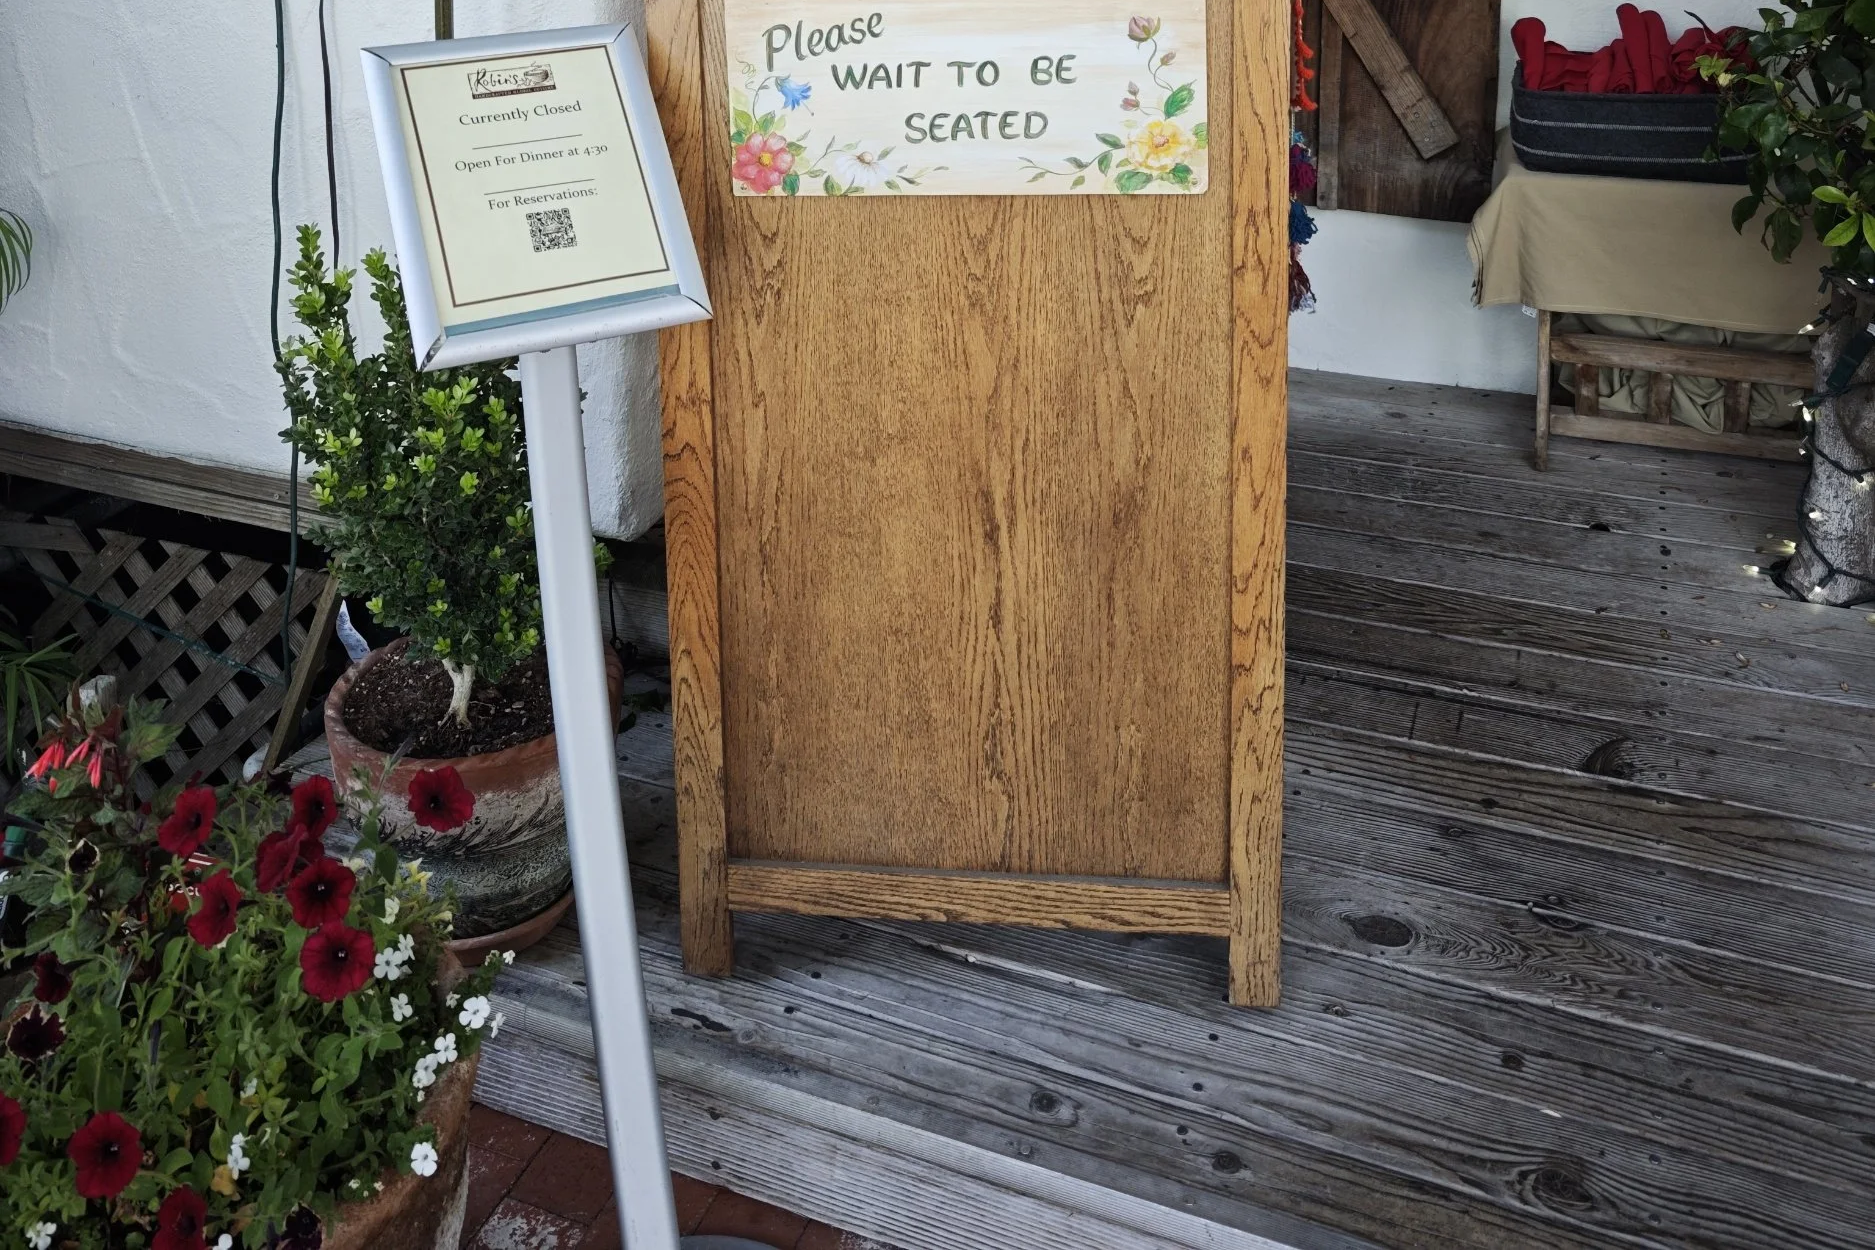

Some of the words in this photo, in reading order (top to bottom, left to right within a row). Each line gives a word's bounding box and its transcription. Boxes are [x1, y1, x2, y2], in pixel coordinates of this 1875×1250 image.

[762, 12, 885, 72] Please
[474, 68, 518, 92] Robin's
[831, 61, 932, 90] WAIT
[947, 60, 1000, 87] TO
[1030, 54, 1077, 86] BE
[459, 108, 529, 125] Currently
[533, 100, 582, 117] Closed
[904, 111, 1049, 144] SEATED
[455, 159, 491, 172] Open
[495, 155, 516, 166] For
[520, 150, 564, 163] Dinner
[567, 147, 580, 156] at
[583, 144, 608, 156] 4:30
[488, 198, 510, 210] For
[514, 187, 598, 206] Reservations:
